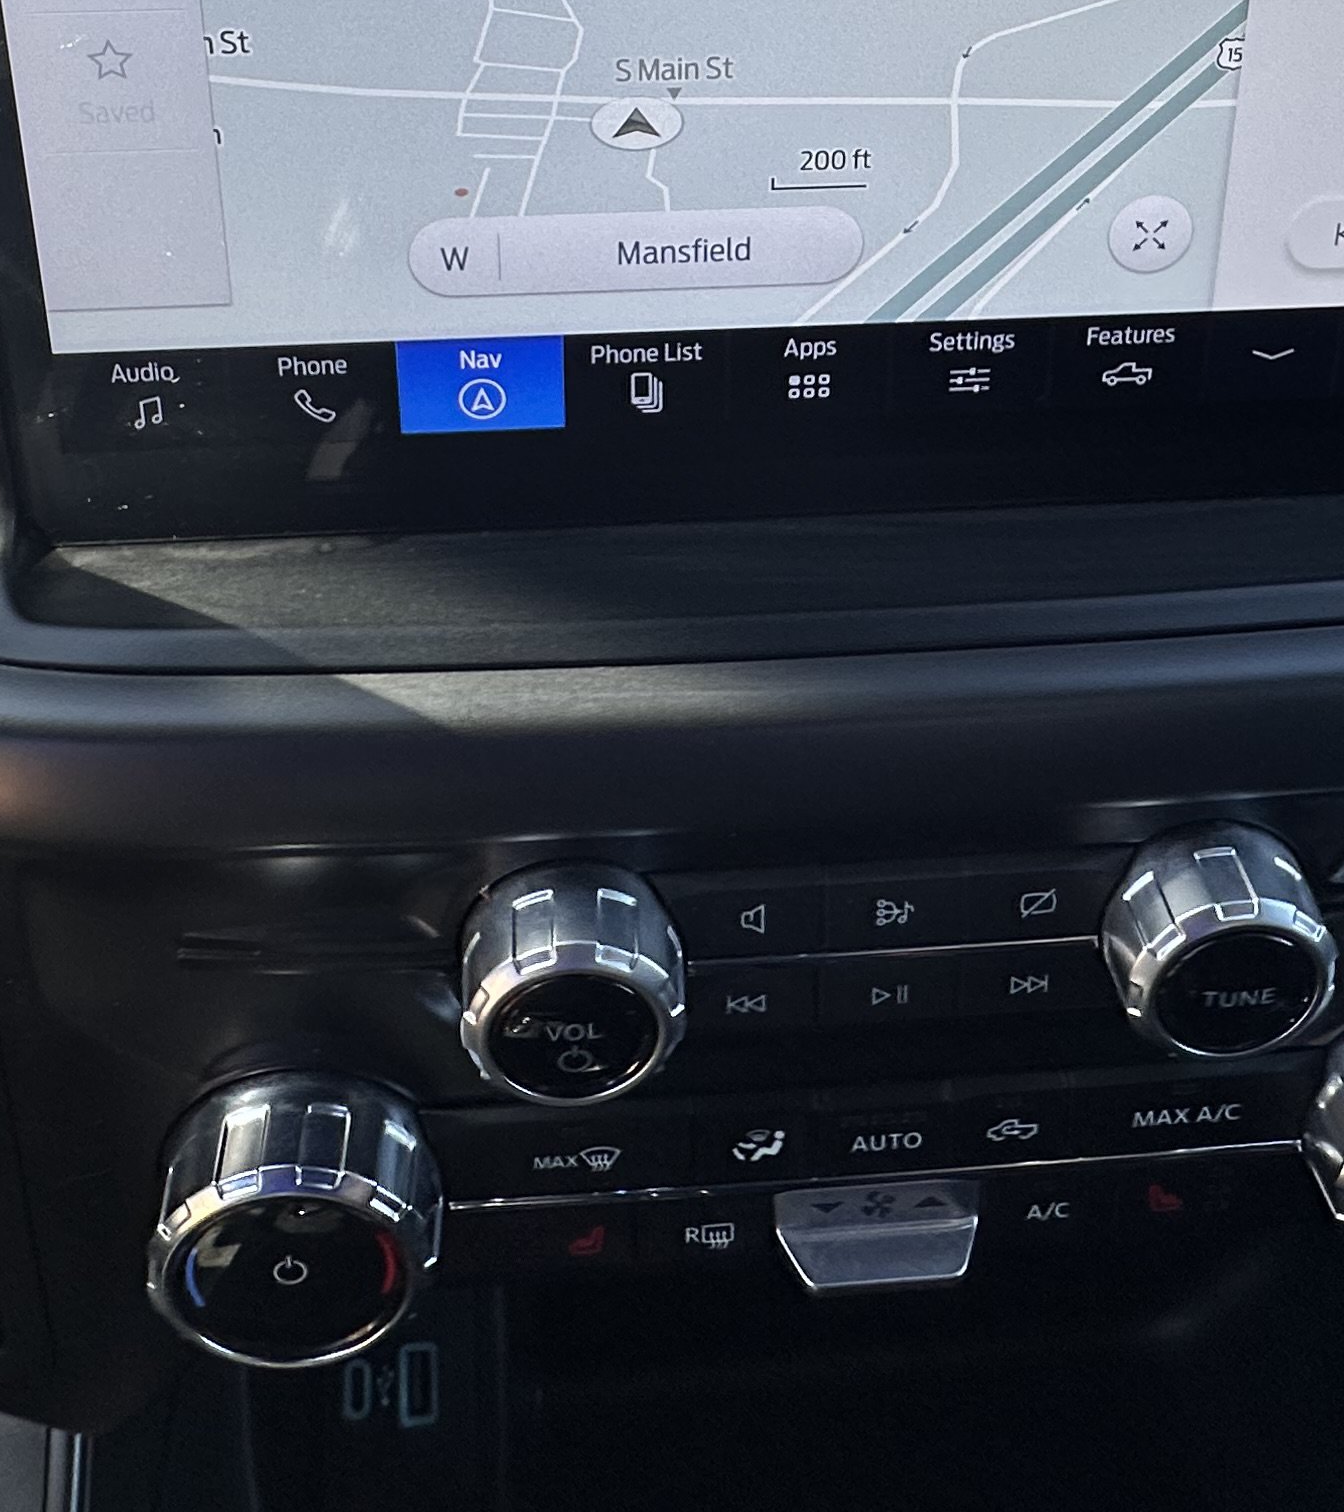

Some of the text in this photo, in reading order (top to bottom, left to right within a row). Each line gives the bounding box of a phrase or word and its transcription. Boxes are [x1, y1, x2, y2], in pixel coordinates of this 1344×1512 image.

[220, 30, 251, 55] St
[1228, 47, 1243, 63] 15
[615, 55, 734, 82] S Main St
[79, 101, 155, 126] Saved
[799, 148, 872, 172] 200 ft
[440, 237, 752, 272] W Mansfield
[929, 329, 1016, 357] Settings
[1086, 324, 1176, 348] Features
[459, 349, 502, 370] Nav
[590, 341, 703, 366] Phone List
[784, 337, 838, 362] Apps
[111, 361, 174, 384] Audio
[277, 355, 348, 378] Phone
[1201, 988, 1276, 1009] TUNE
[545, 1021, 600, 1042] VOL
[1132, 1103, 1243, 1129] MAX A/C
[851, 1131, 923, 1153] AUTO
[533, 1155, 579, 1170] MAX
[1027, 1201, 1070, 1221] A/C
[684, 1227, 700, 1244] R
